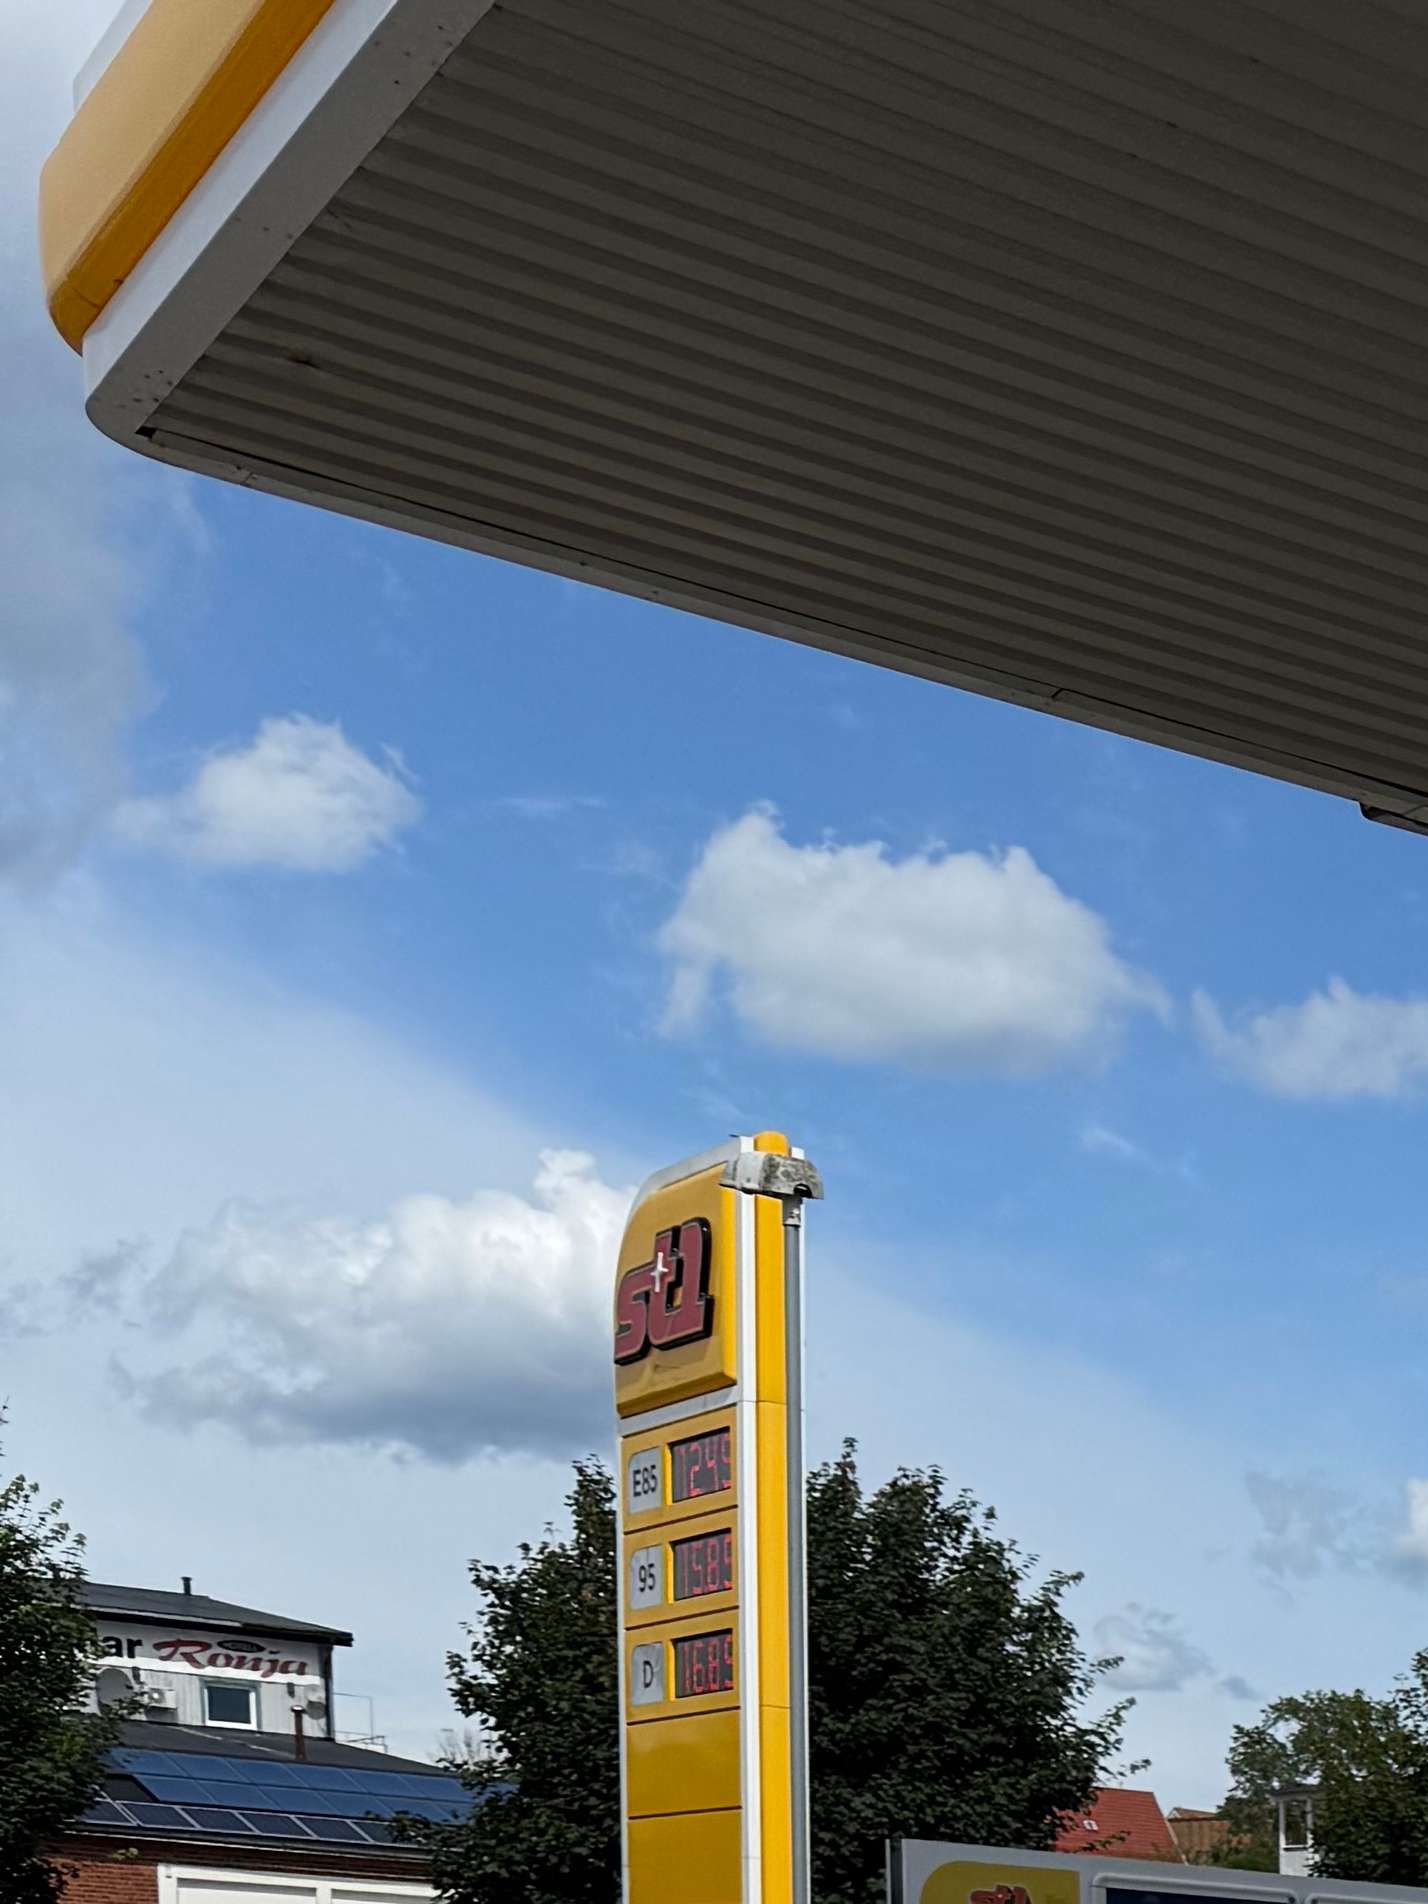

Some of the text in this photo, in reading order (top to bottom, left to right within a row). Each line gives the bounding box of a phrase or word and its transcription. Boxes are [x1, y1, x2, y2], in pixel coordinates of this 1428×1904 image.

[633, 1464, 657, 1498] E85
[638, 1563, 656, 1593] 95
[153, 1638, 308, 1678] Ronja
[643, 1660, 654, 1689] D
